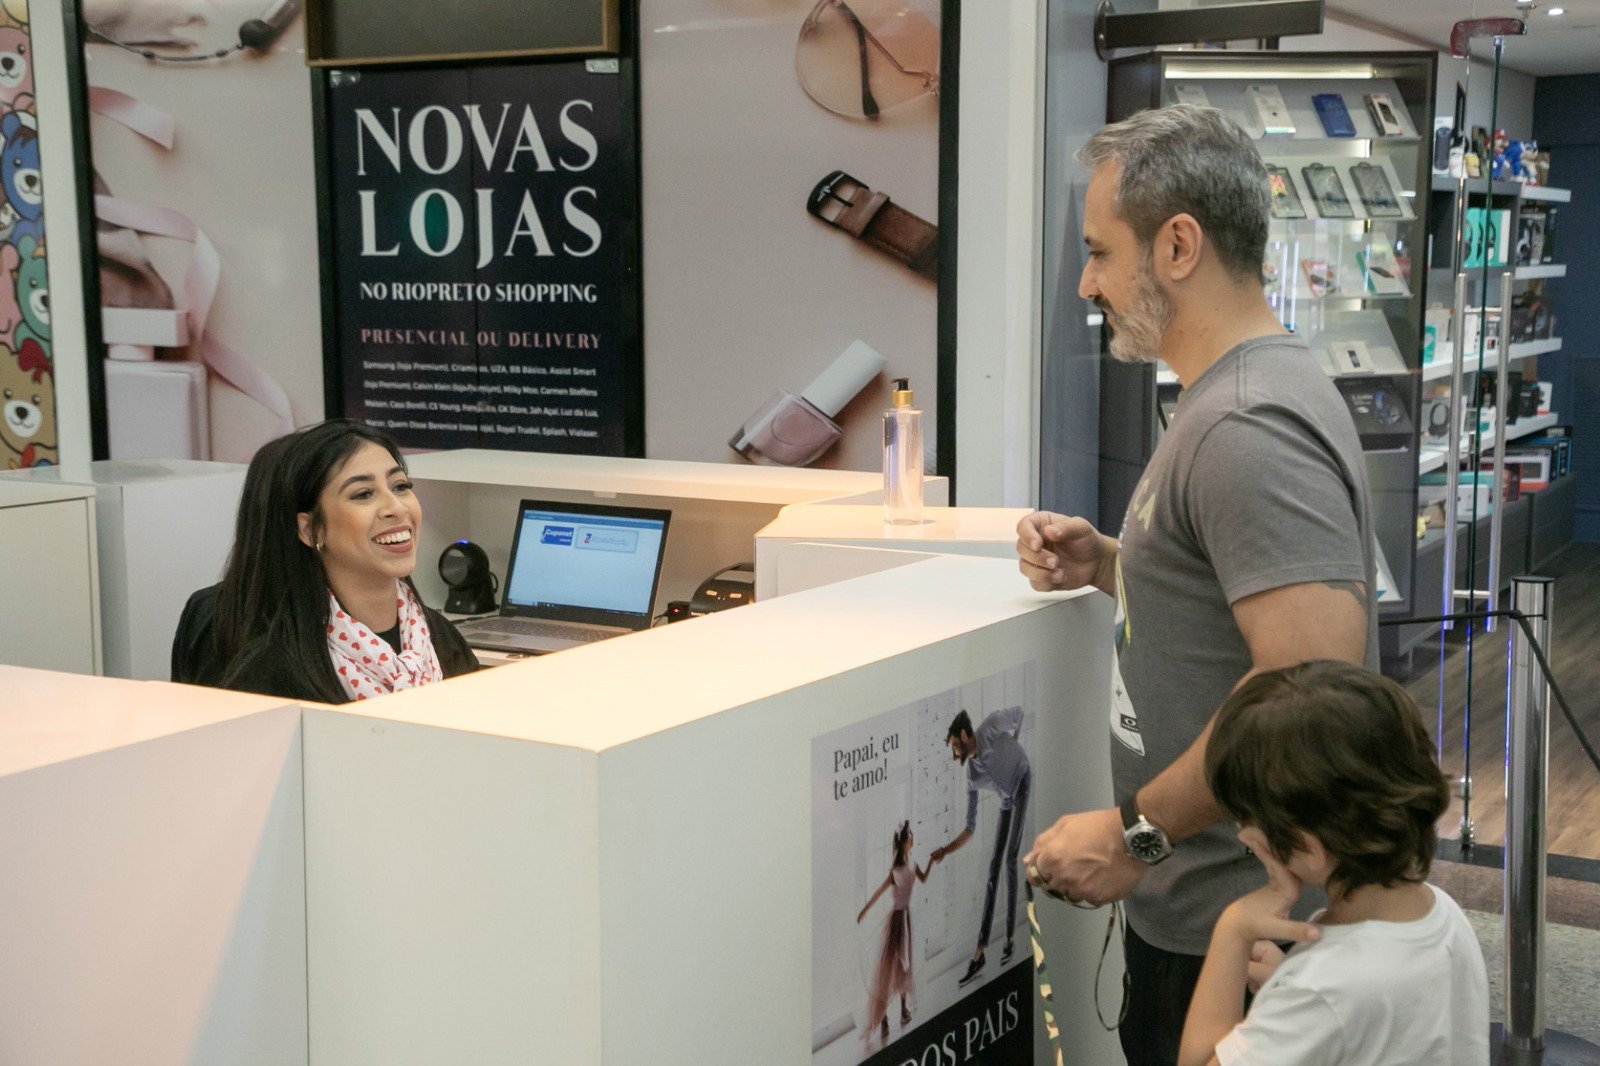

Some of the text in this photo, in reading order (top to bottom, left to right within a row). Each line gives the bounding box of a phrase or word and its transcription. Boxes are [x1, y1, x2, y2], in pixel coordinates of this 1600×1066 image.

[354, 99, 598, 176] NOVAS
[357, 186, 602, 270] LOJAS
[361, 282, 598, 303] NO RIOPRETO SHOPPING
[361, 328, 600, 349] PRESENCIAL OU DELIVERY
[834, 733, 899, 773] Papai, eu
[834, 758, 888, 801] te amo!
[898, 989, 1019, 1066] OS PAIS
